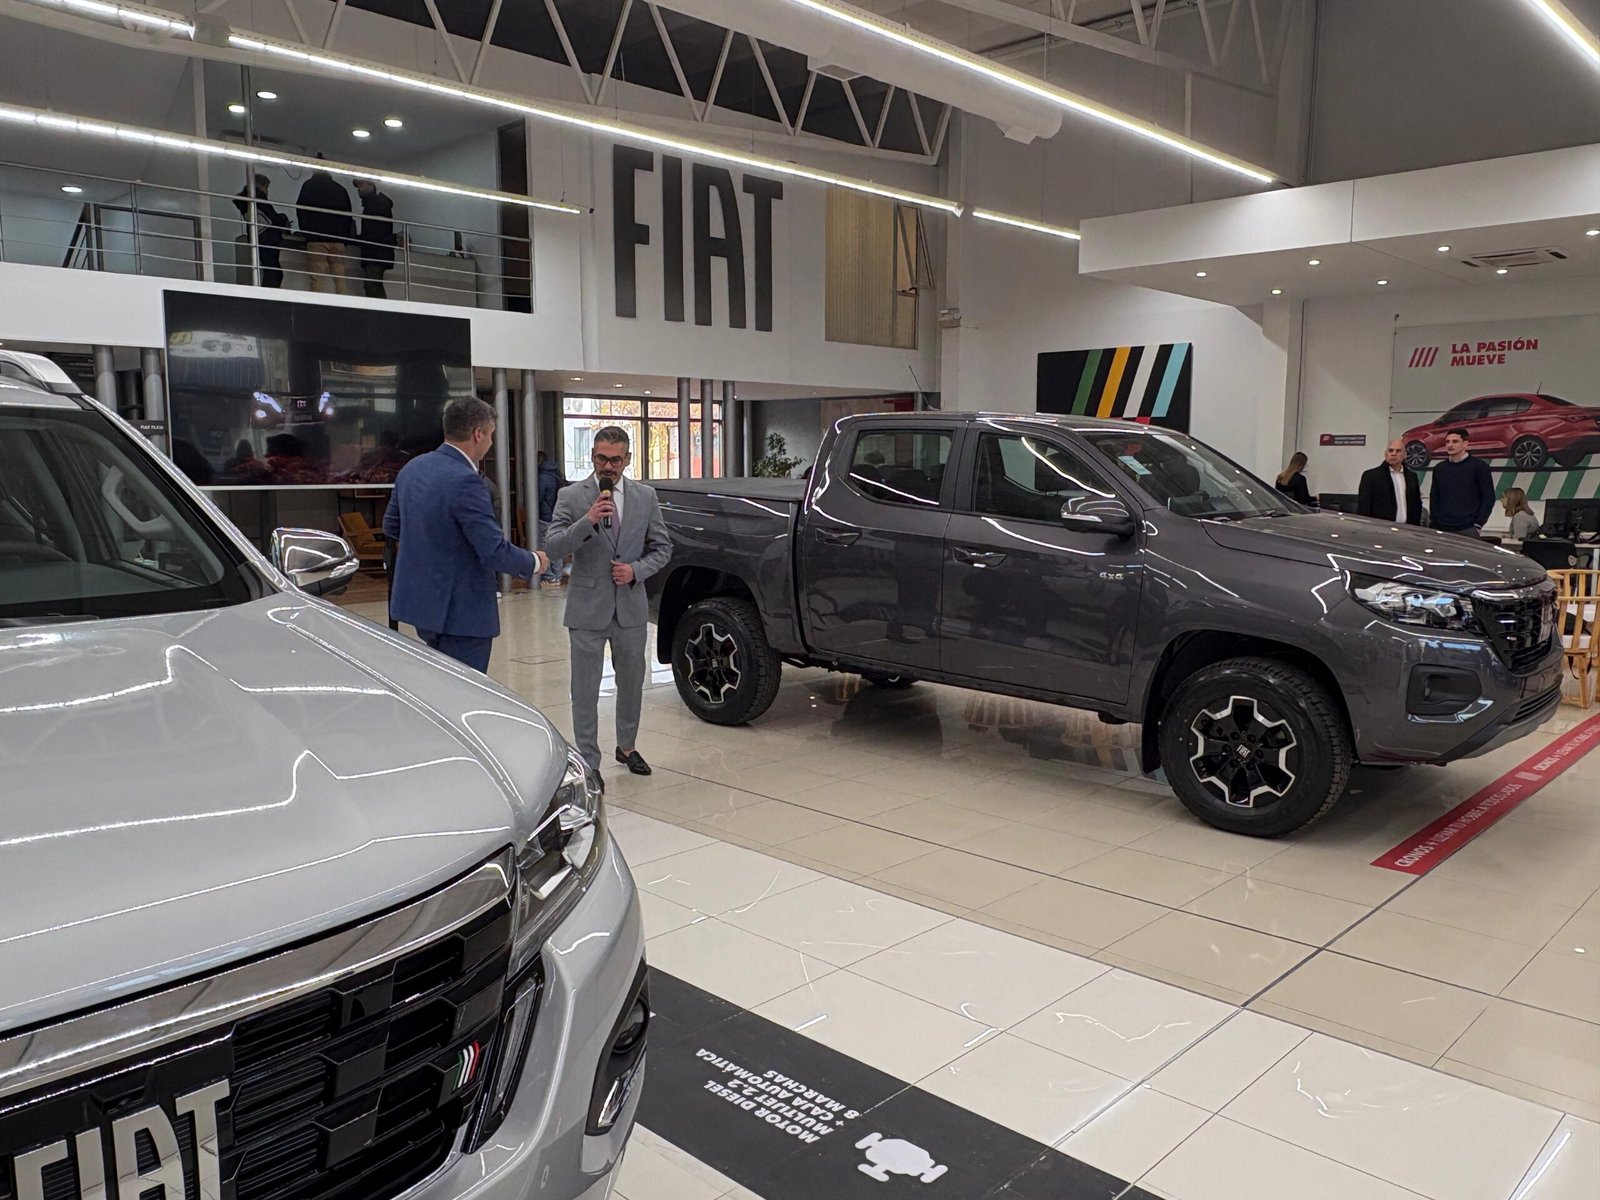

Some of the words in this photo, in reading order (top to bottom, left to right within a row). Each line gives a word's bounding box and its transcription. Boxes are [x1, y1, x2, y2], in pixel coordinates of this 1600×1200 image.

[614, 144, 783, 332] FIAT
[1452, 343, 1471, 354] LA
[1477, 337, 1539, 353] PASIÓN
[1450, 353, 1506, 367] MUEVE
[1394, 845, 1436, 867] CRONOS
[695, 1048, 794, 1099] AUTOMÁTICA
[727, 1078, 759, 1096] 2.2
[703, 1080, 757, 1111] DIESEL
[762, 1069, 846, 1112] MARCHAS
[753, 1094, 835, 1135] MULTIJET
[791, 1096, 835, 1121] CAJA
[843, 1109, 860, 1120] 8
[754, 1107, 821, 1144] MOTOR
